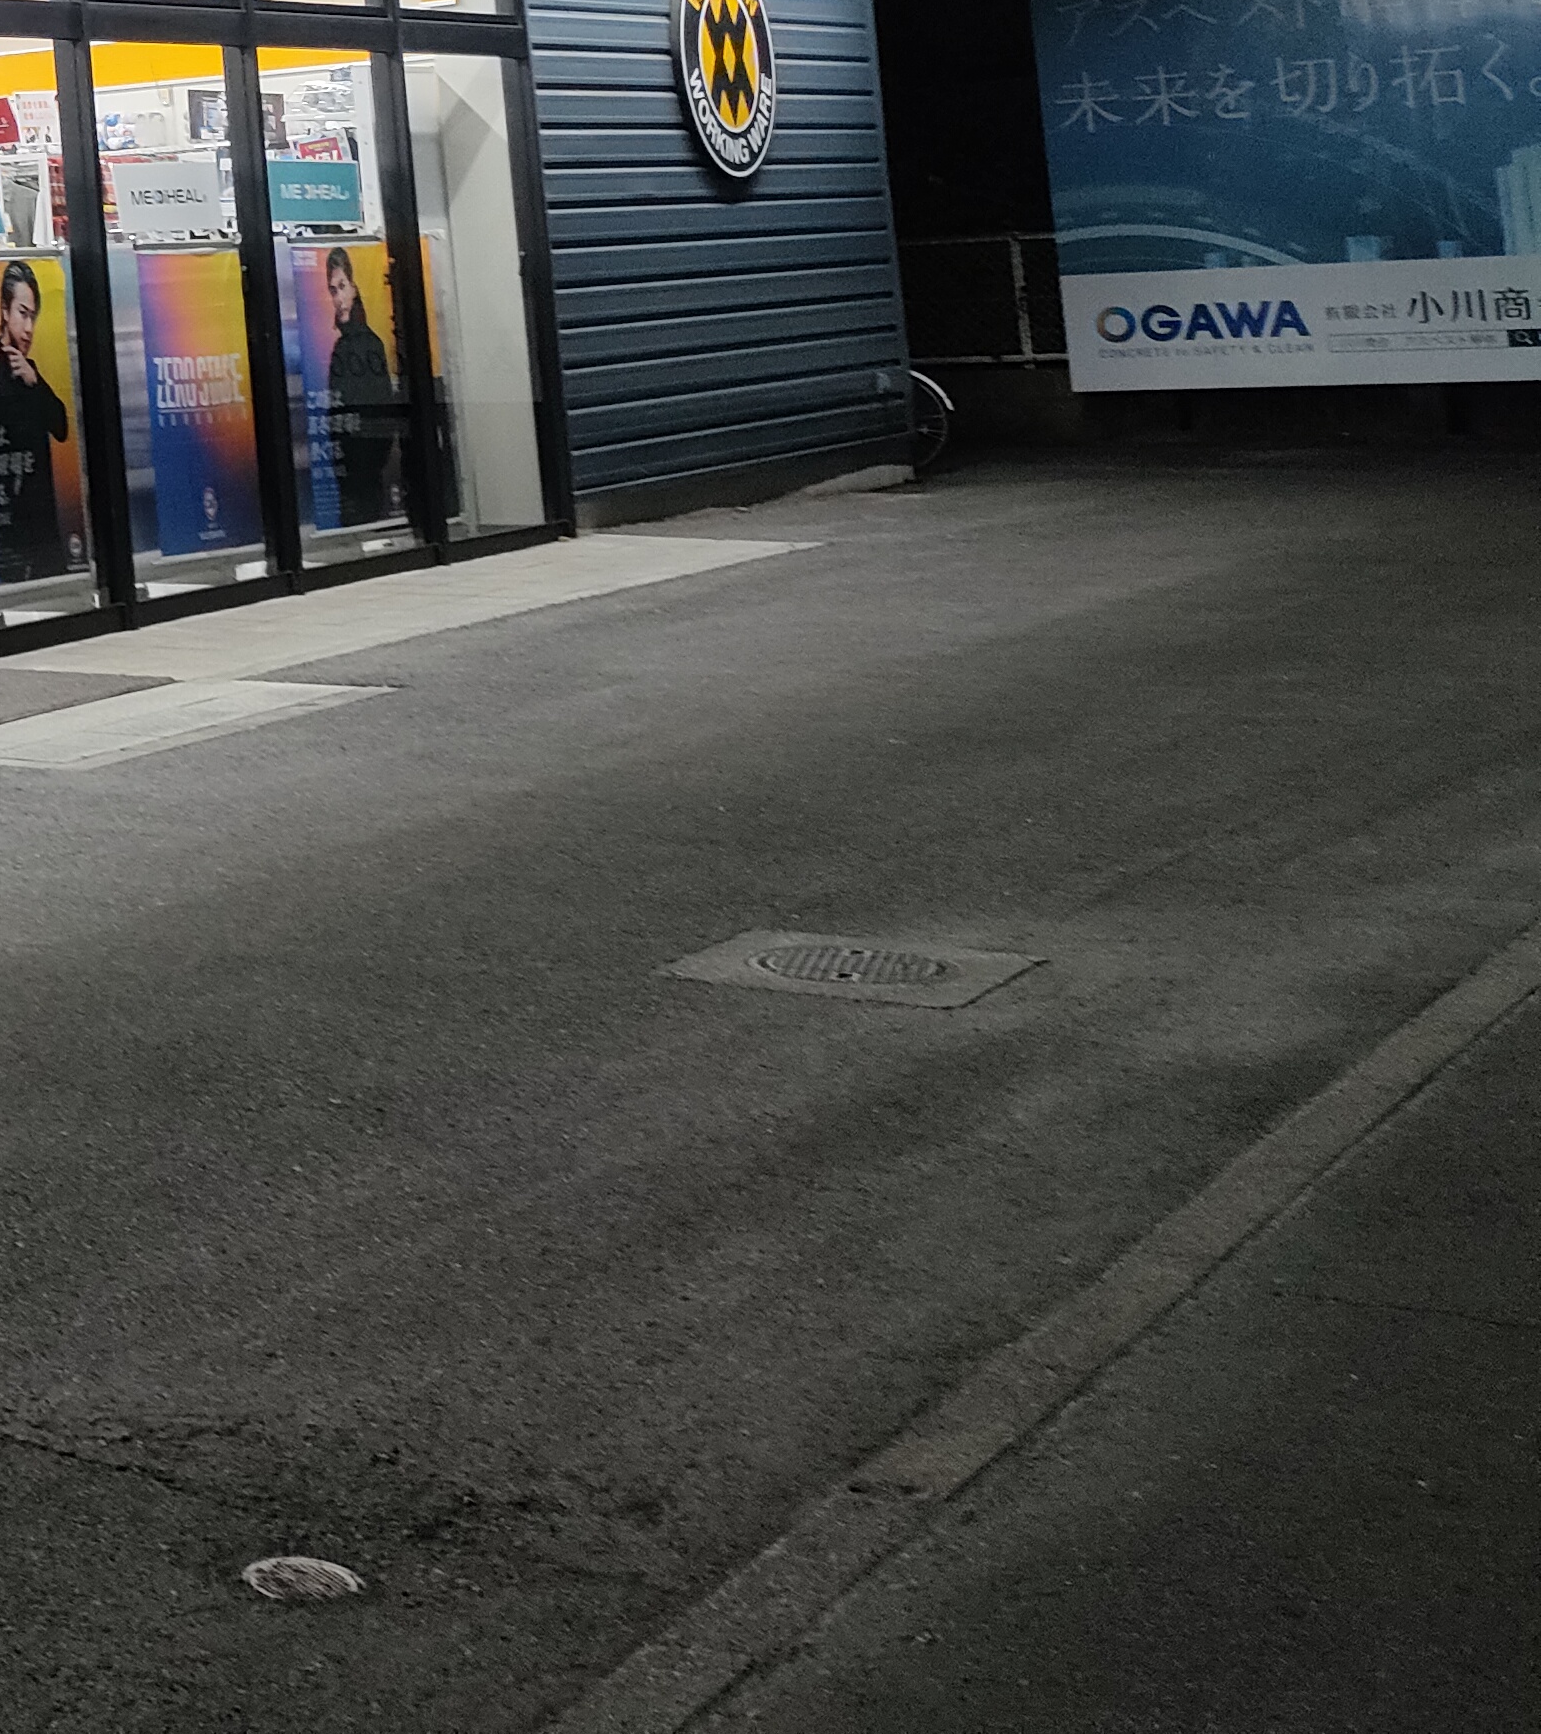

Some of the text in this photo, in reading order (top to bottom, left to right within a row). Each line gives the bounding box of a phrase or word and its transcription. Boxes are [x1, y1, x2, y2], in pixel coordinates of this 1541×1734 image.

[689, 67, 773, 165] WORKING WARE
[1096, 300, 1312, 344] OGAWA
[1407, 287, 1541, 324] 小川商
